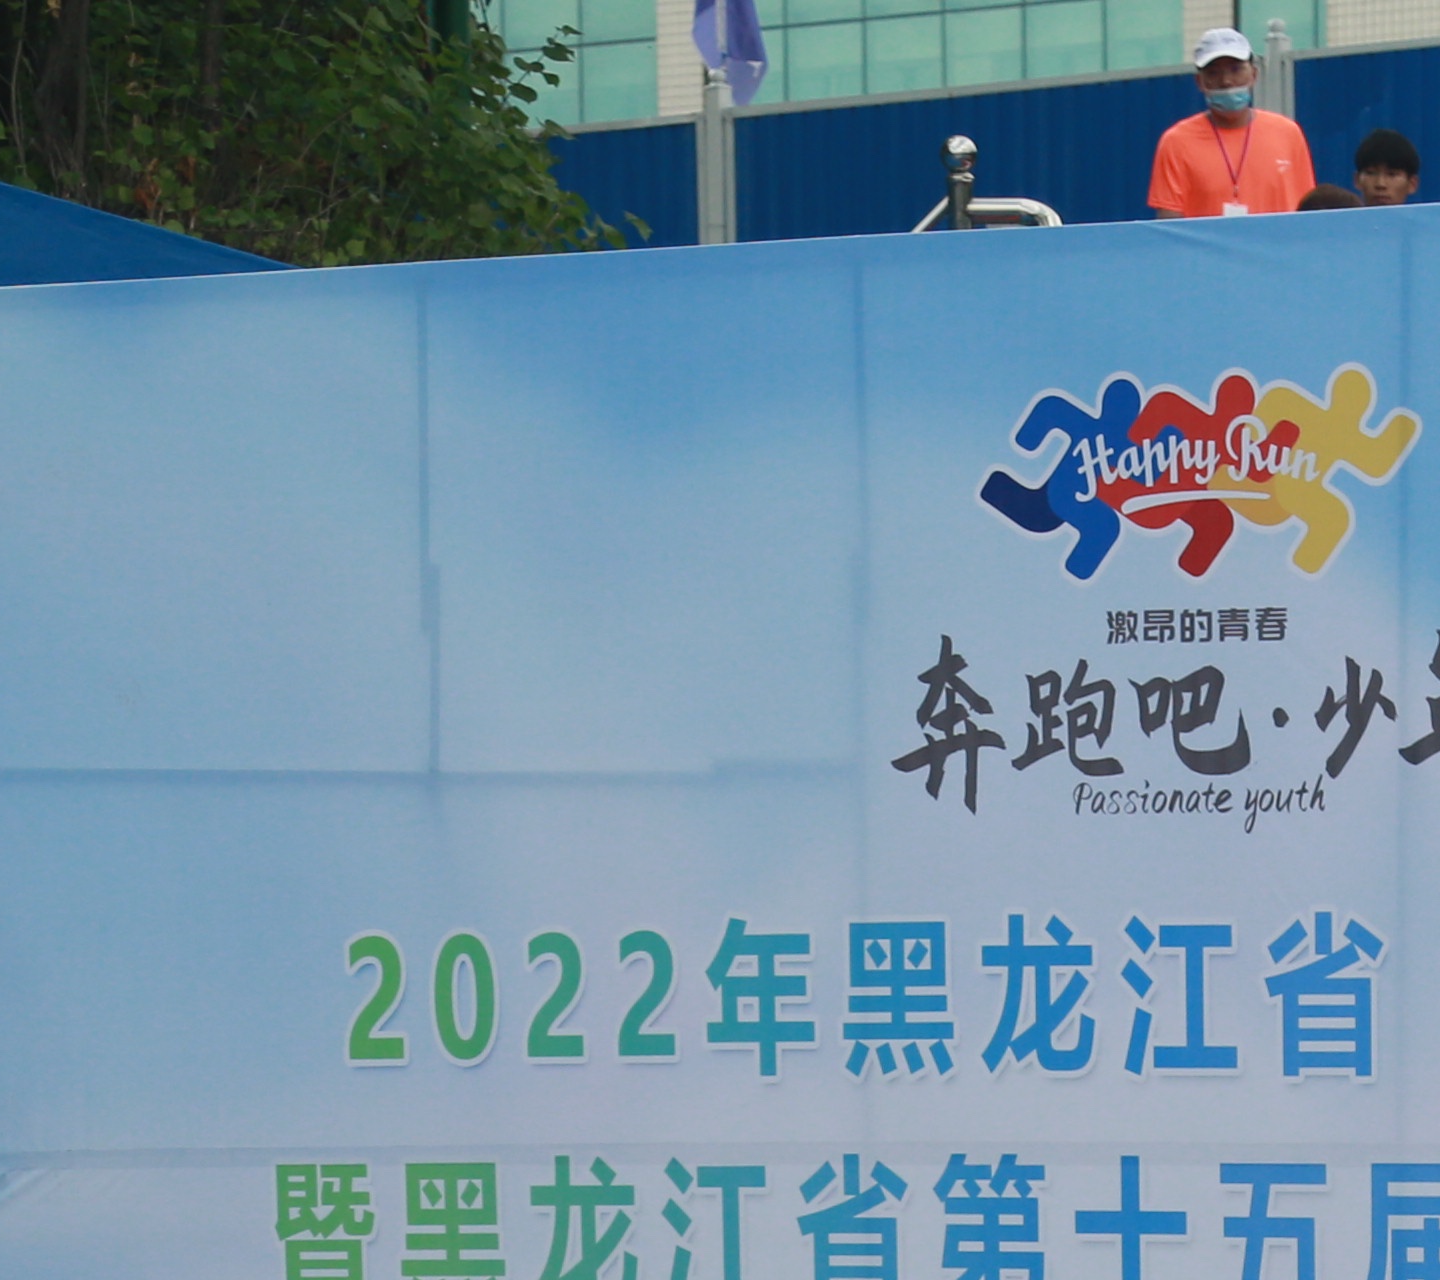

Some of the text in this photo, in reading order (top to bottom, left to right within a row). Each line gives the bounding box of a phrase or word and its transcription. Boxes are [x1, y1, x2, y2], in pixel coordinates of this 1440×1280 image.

[1072, 417, 1322, 503] Happy Run
[1105, 606, 1290, 644] 激昂的青春
[1073, 774, 1327, 835] Passionate youth
